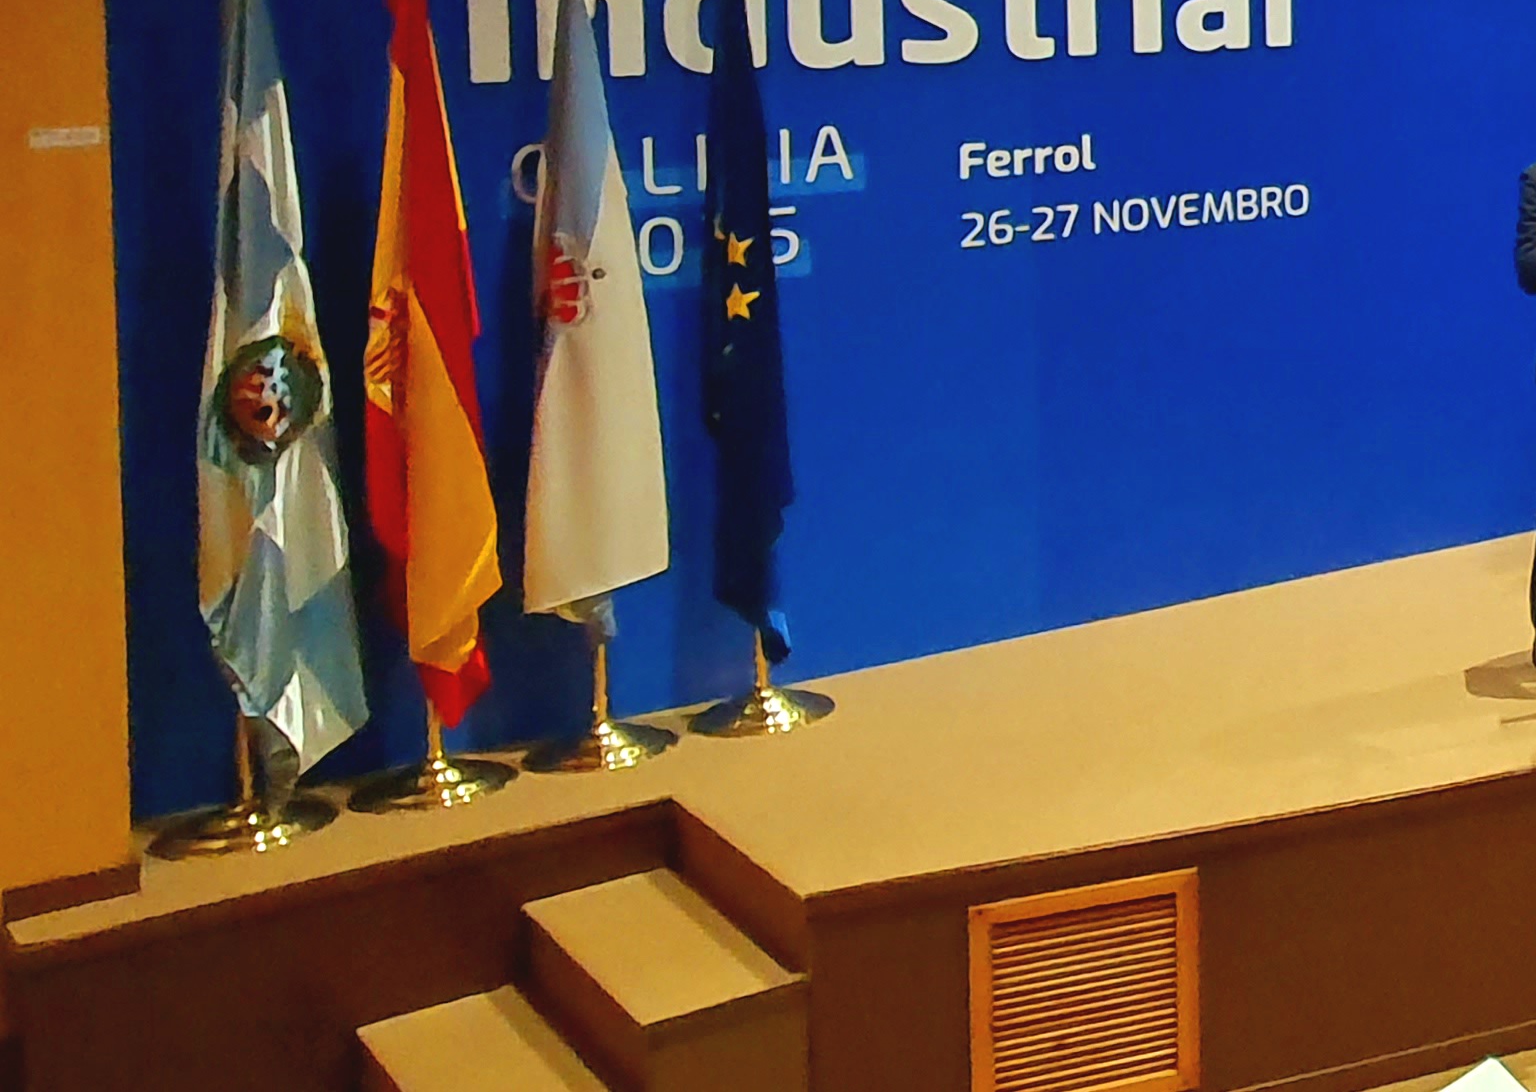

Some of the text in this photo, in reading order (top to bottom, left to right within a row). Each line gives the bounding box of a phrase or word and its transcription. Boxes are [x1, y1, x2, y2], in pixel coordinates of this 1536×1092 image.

[959, 134, 1096, 179] Ferrol
[960, 182, 1312, 251] 26-27 NOVEMBRO
